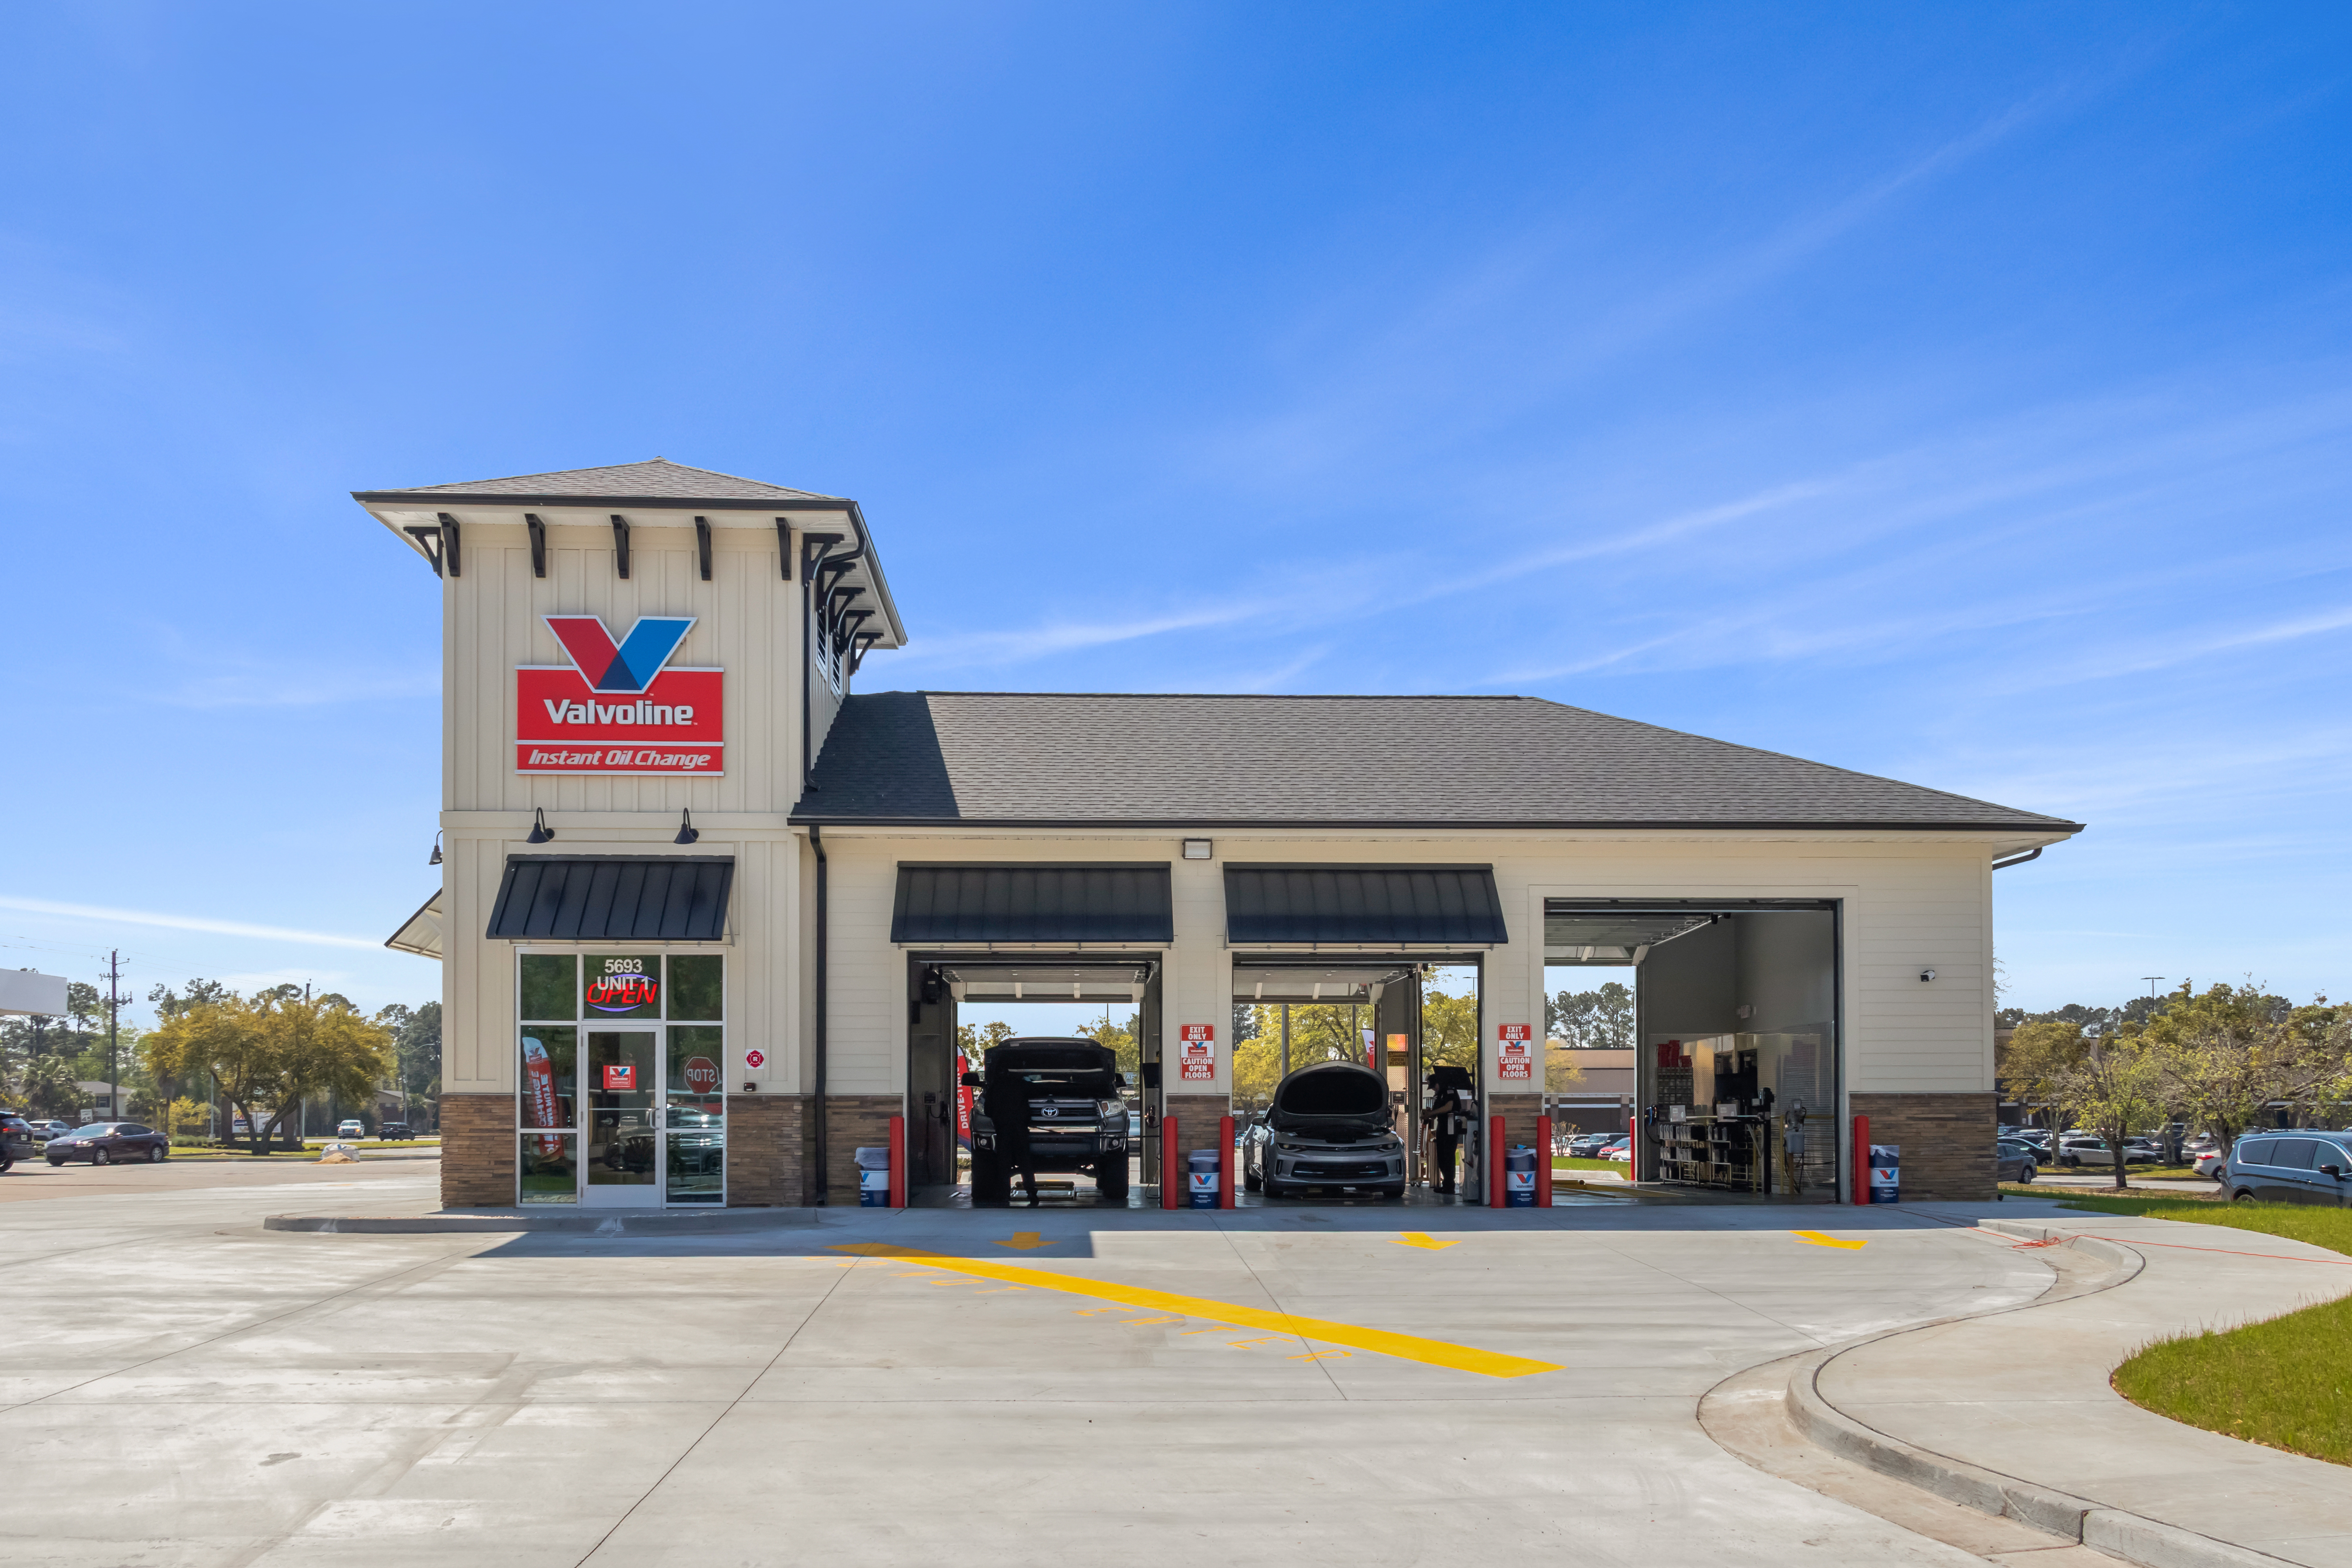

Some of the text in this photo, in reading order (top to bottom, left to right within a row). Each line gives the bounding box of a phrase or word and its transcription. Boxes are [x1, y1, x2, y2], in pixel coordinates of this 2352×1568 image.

[543, 699, 693, 725] Valvoline
[528, 749, 711, 769] Instant Oil Change
[604, 958, 643, 973] 5693
[587, 983, 658, 1003] OPEN
[597, 976, 649, 990] UNIT 1
[1071, 1306, 1352, 1363] ENTER
